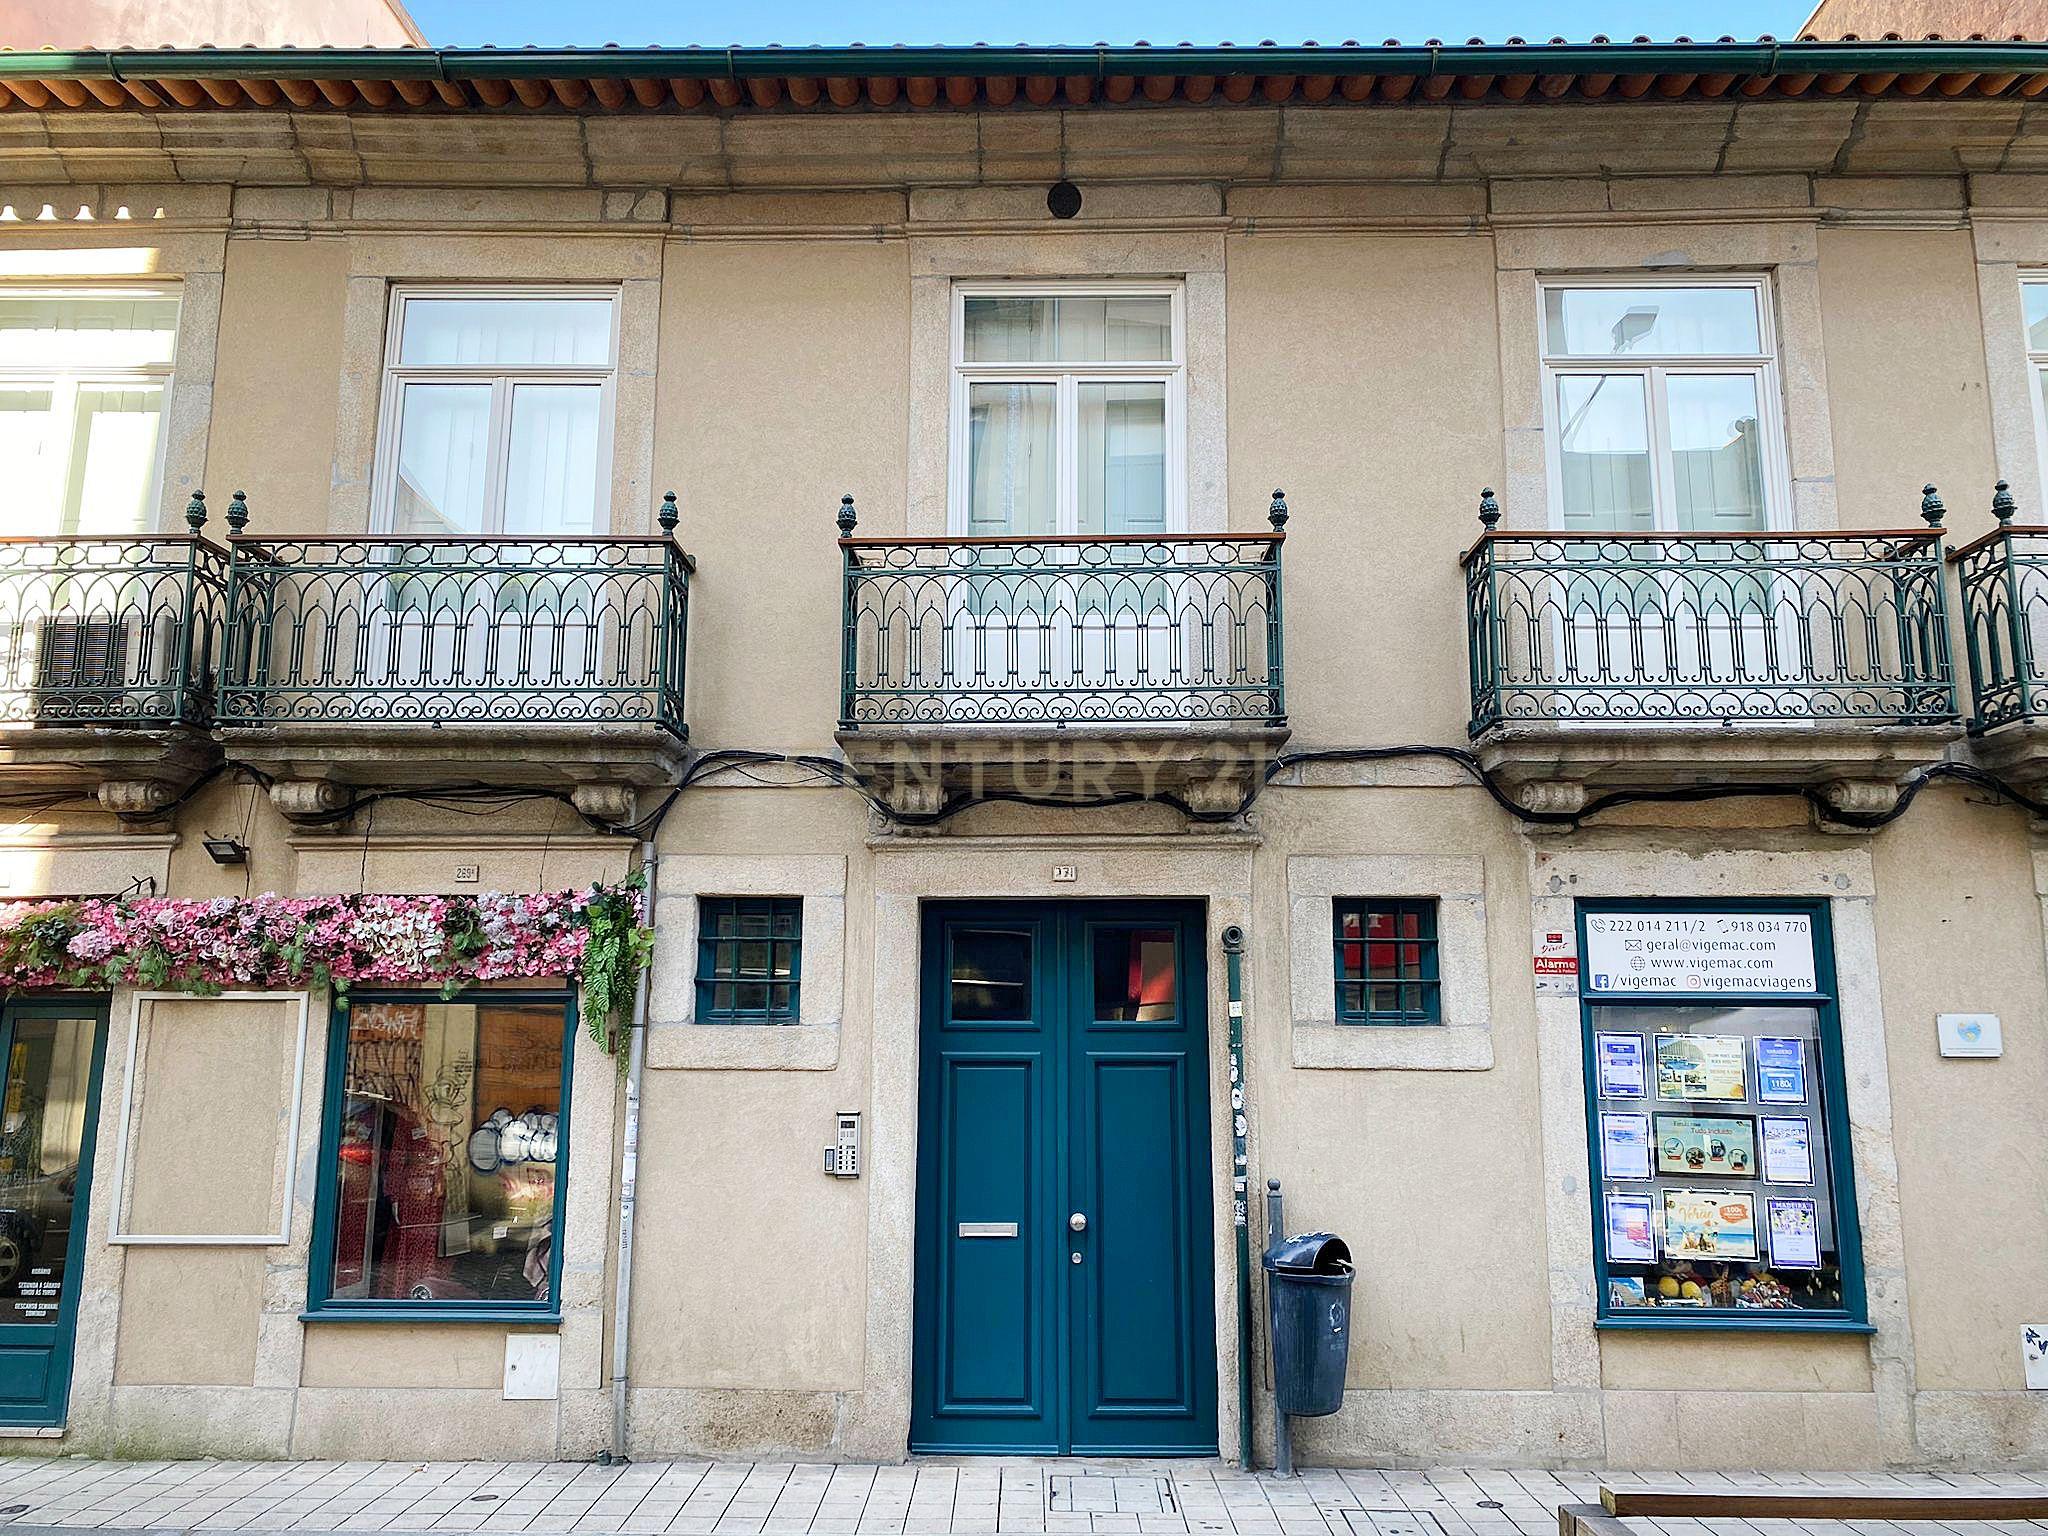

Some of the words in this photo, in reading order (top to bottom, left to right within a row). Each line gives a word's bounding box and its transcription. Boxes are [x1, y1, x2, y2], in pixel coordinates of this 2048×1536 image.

[1609, 920, 1633, 931] 222
[1637, 920, 1661, 931] 014
[1665, 919, 1706, 934] 211/2
[1731, 921, 1754, 932] 918
[1757, 921, 1780, 932] 034
[1784, 921, 1807, 932] 770
[1646, 938, 1776, 953] geral@vigemac.com
[1535, 959, 1576, 969] Alarme
[1650, 956, 1773, 971] www.vigemac.com
[1703, 974, 1812, 990] vigemacviagens
